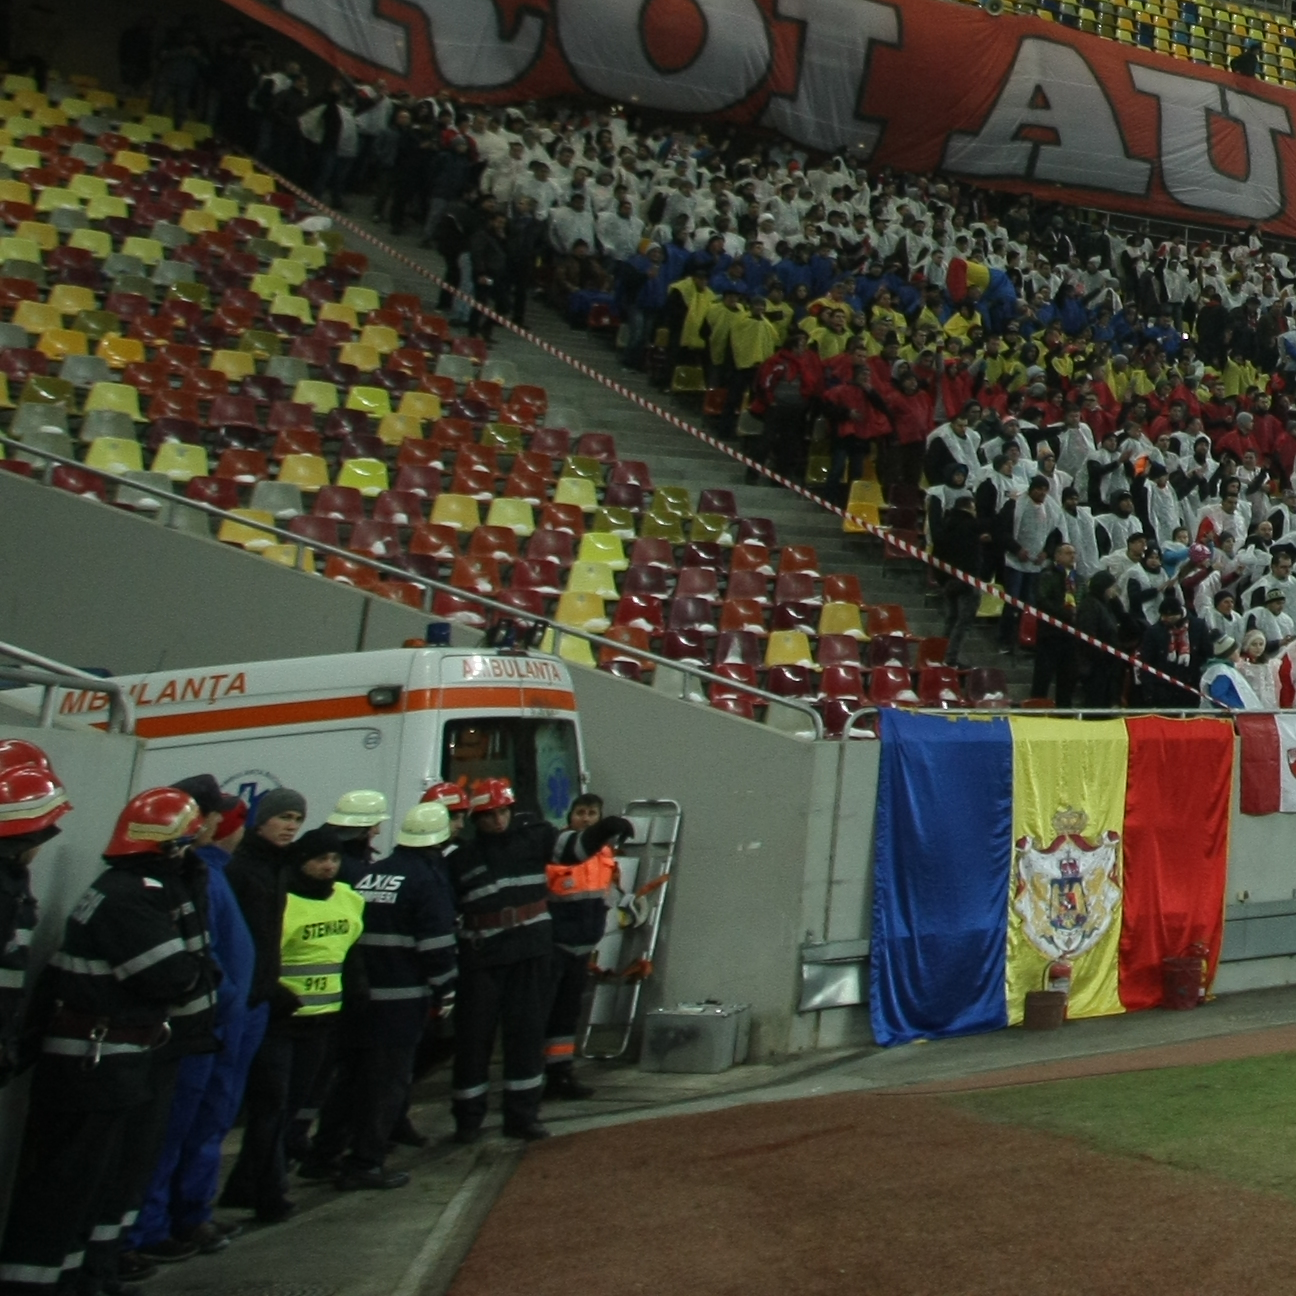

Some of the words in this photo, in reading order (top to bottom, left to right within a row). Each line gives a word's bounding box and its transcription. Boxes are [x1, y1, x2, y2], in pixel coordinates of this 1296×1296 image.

[939, 34, 1291, 221] AU
[355, 873, 405, 891] AXIS
[302, 918, 350, 940] STEWARD
[304, 977, 328, 991] 913
